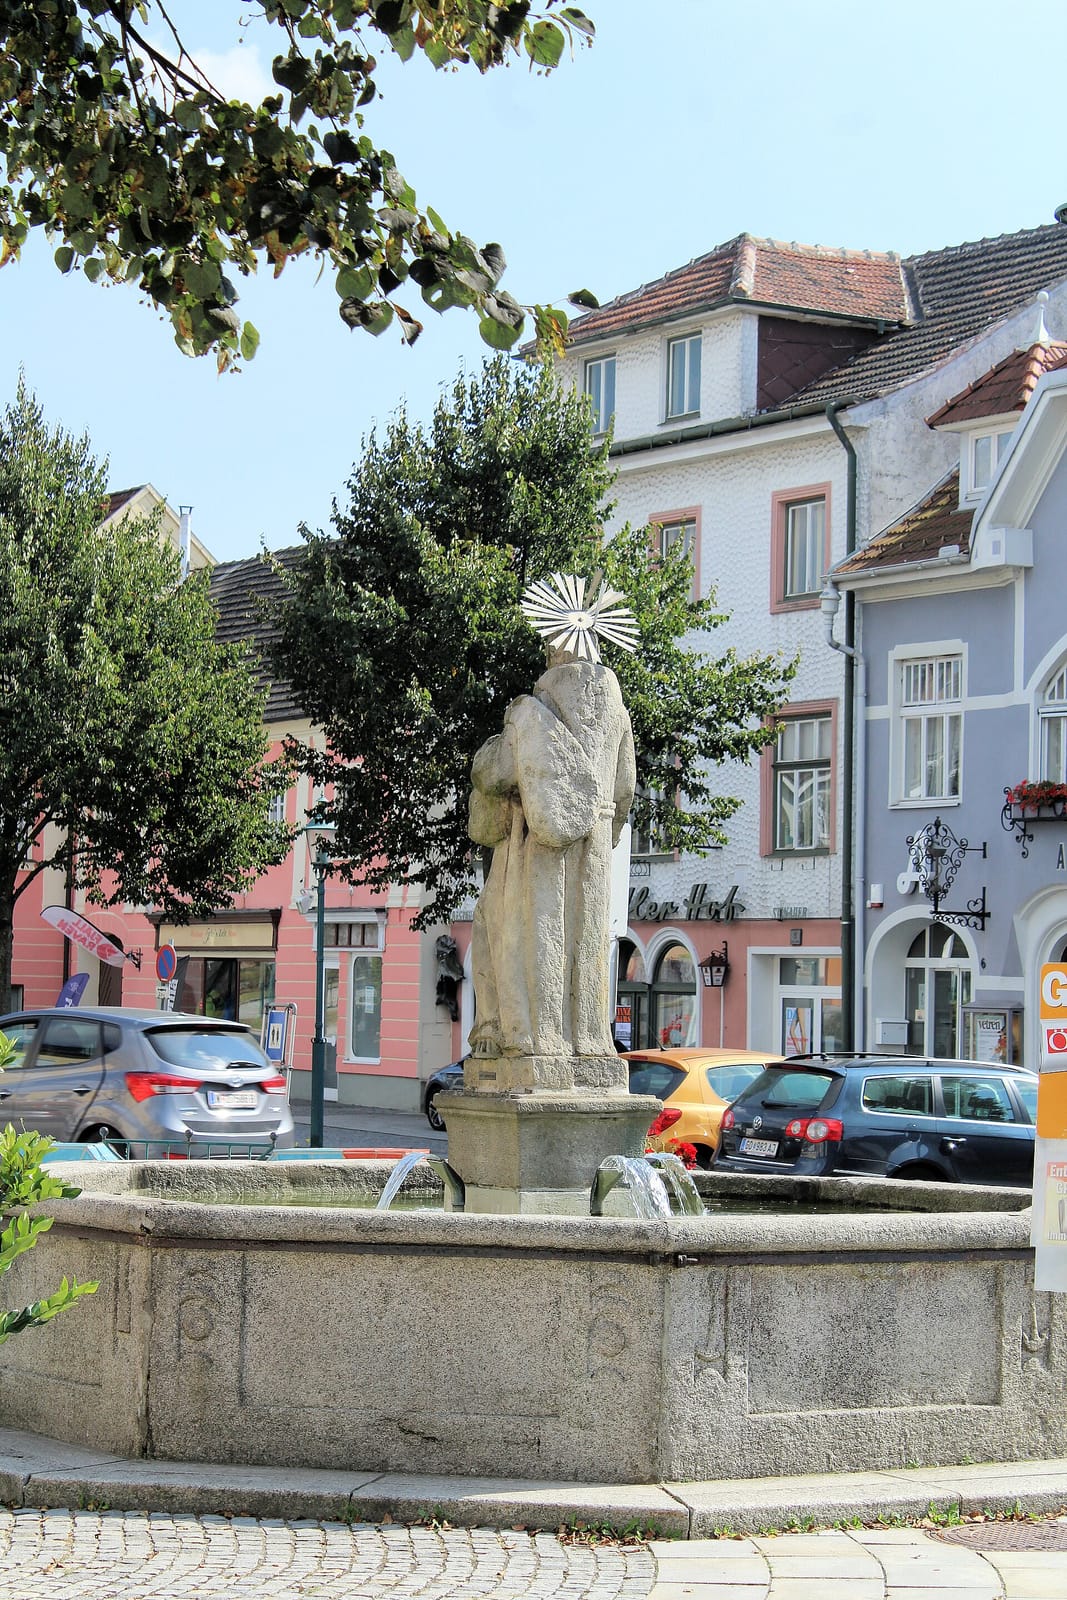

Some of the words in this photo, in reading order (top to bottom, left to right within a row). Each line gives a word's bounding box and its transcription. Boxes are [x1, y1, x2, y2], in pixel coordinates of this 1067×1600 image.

[1055, 842, 1065, 870] A
[683, 883, 746, 925] Hof
[980, 958, 986, 969] 6
